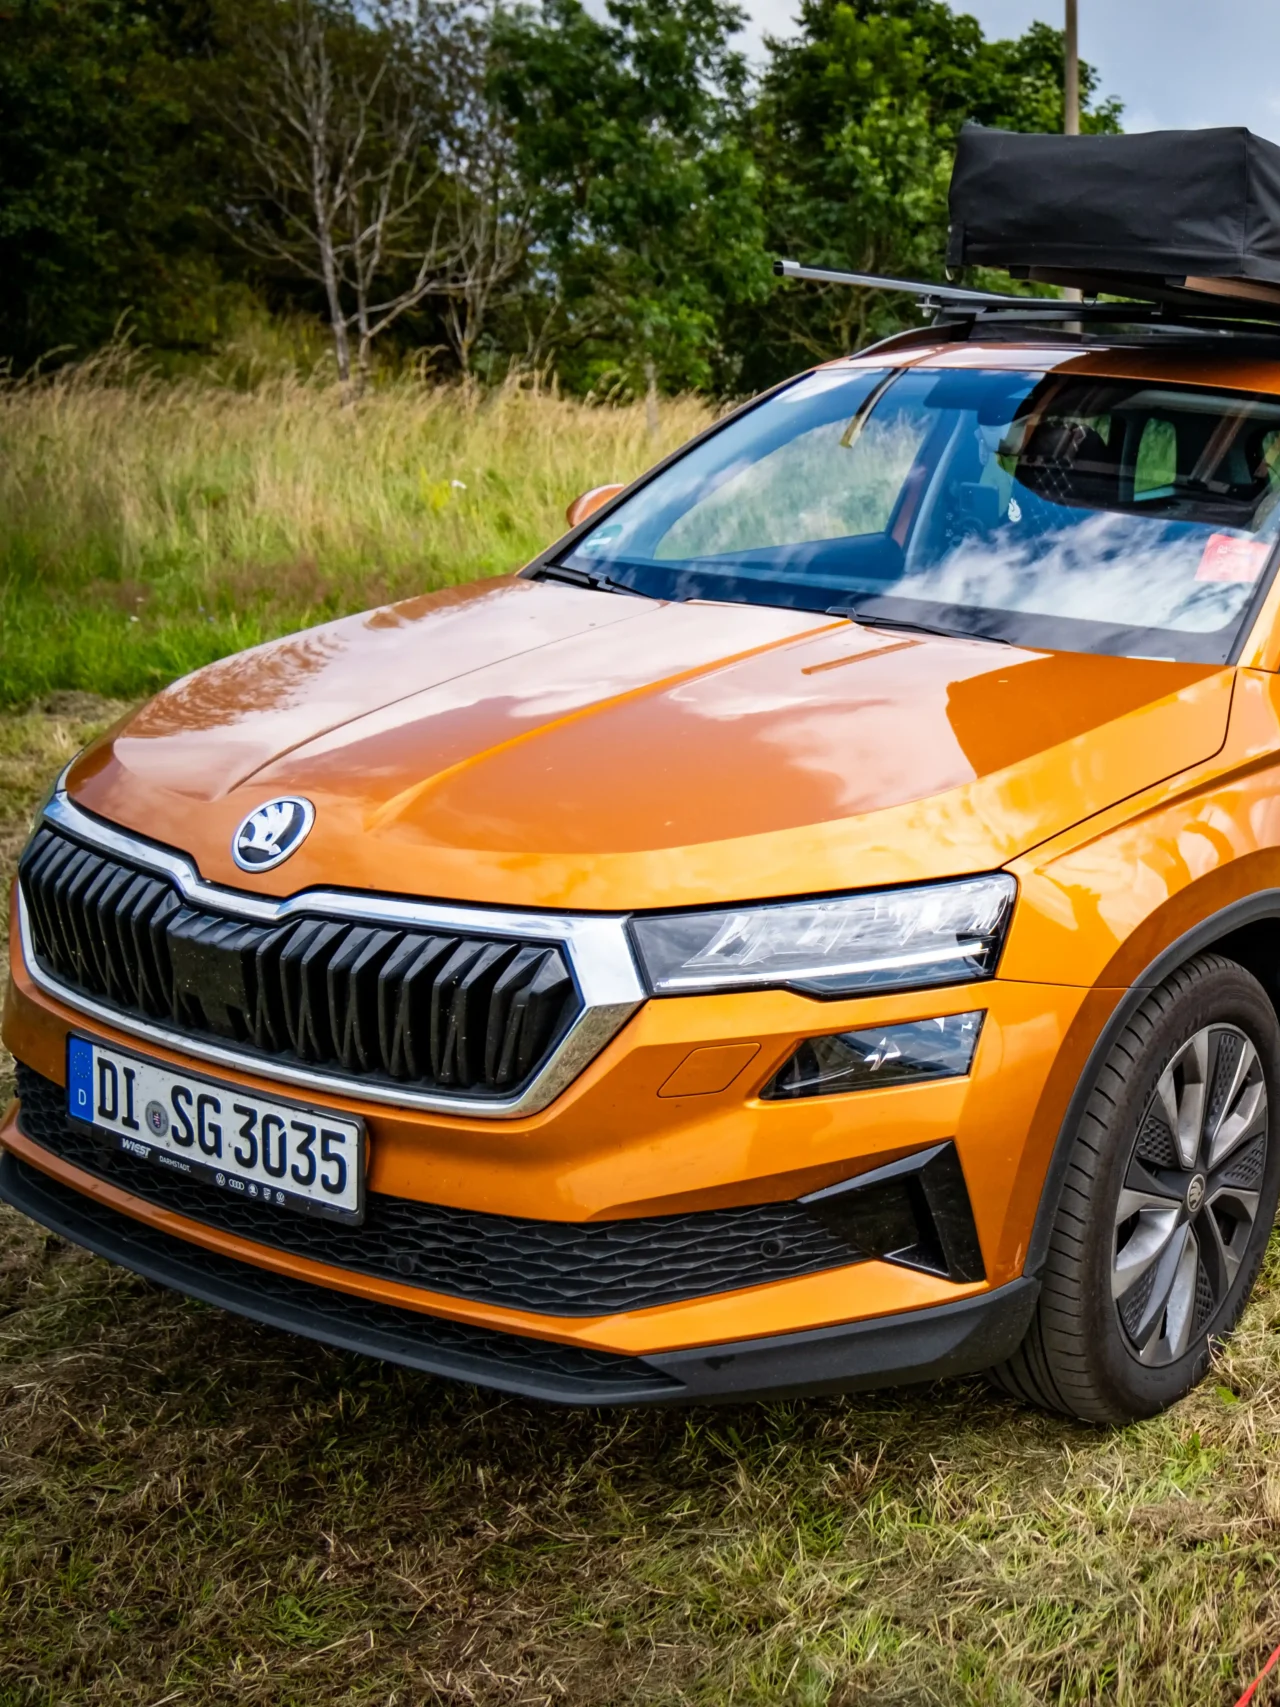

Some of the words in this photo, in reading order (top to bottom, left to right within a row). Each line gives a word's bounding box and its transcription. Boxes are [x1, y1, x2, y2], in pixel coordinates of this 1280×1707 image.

[78, 1088, 87, 1106] D
[97, 1056, 140, 1131] DI
[171, 1085, 222, 1159] SG
[233, 1103, 347, 1195] 3035
[122, 1138, 151, 1159] WIEST
